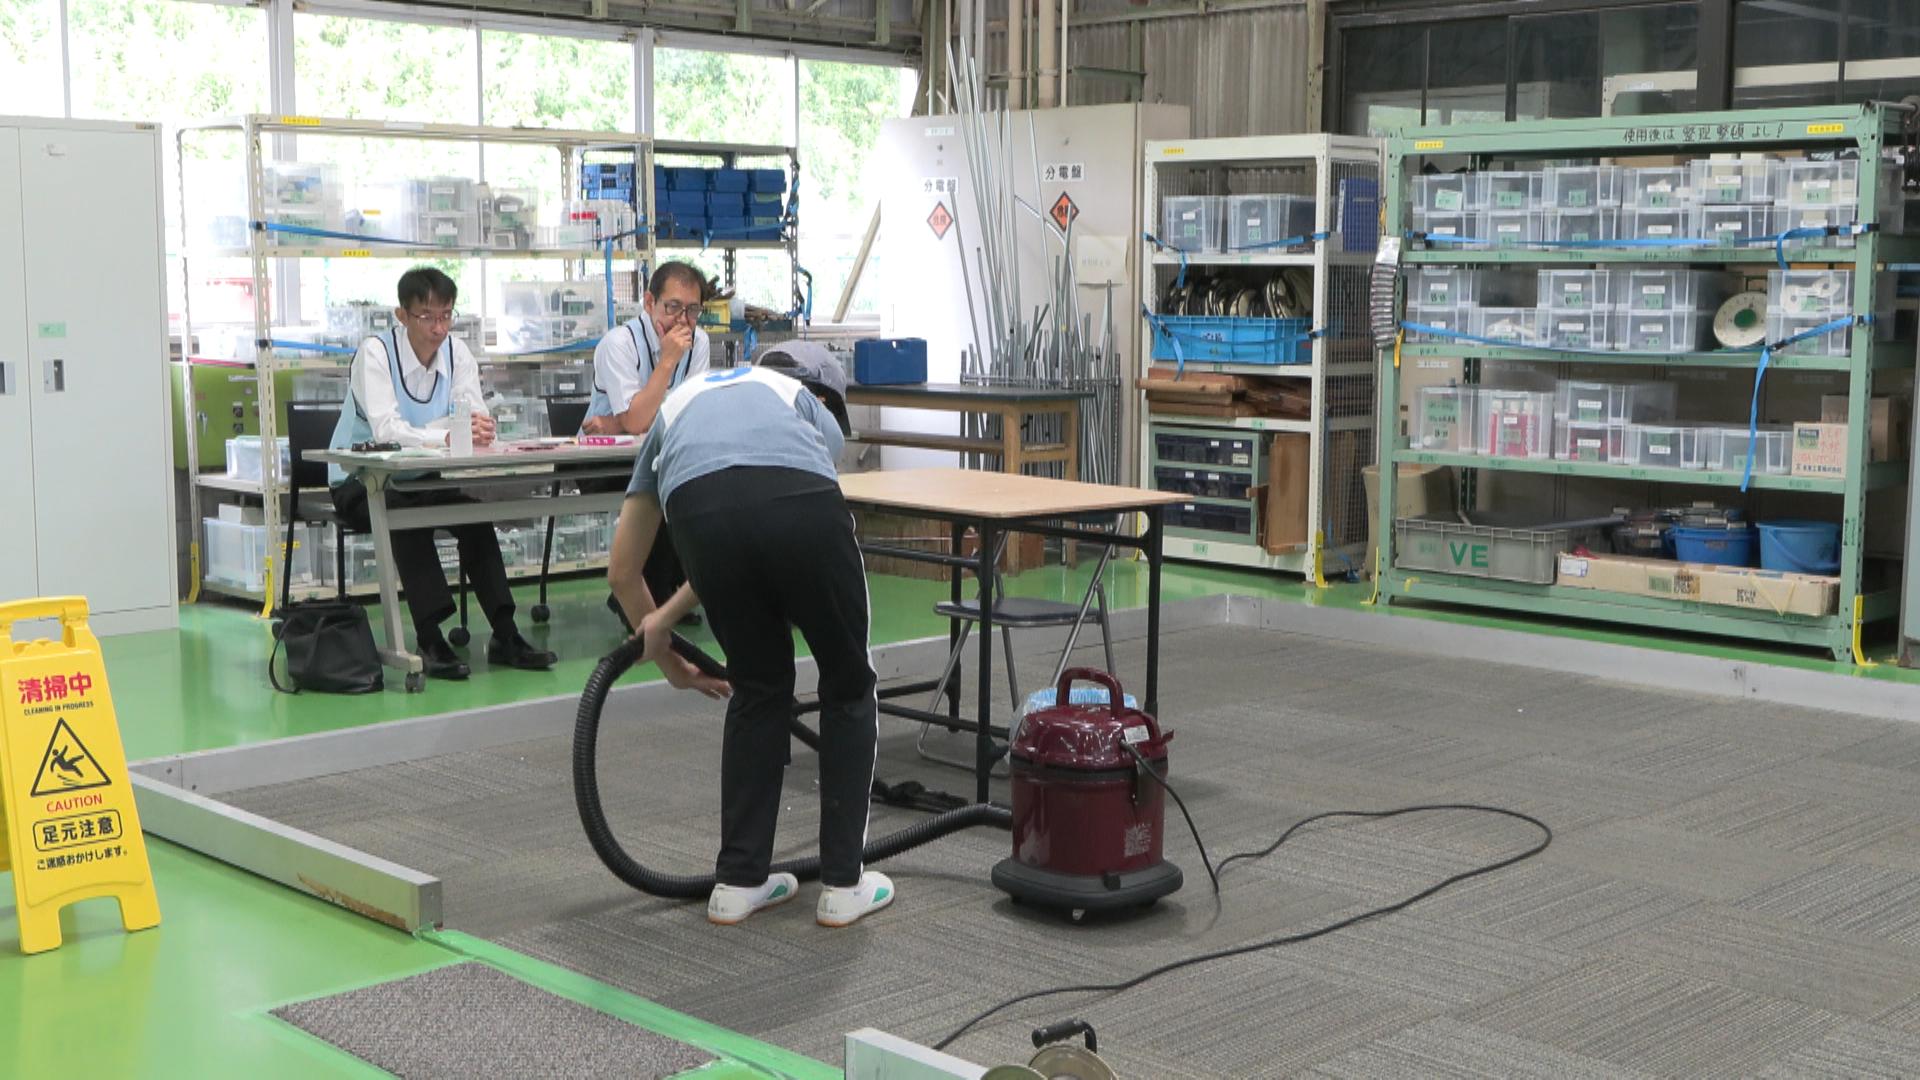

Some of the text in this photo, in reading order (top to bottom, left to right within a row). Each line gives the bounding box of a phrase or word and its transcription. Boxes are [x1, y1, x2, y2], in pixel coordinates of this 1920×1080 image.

[1044, 165, 1082, 180] 分電盤
[1448, 542, 1489, 568] VE
[18, 671, 92, 704] 清掃中
[23, 700, 94, 716] CLEANING IN PROGRESS
[46, 793, 103, 813] CAUTION
[42, 816, 114, 845] 足元注意
[37, 845, 128, 870] ご迷惑おかけします。
